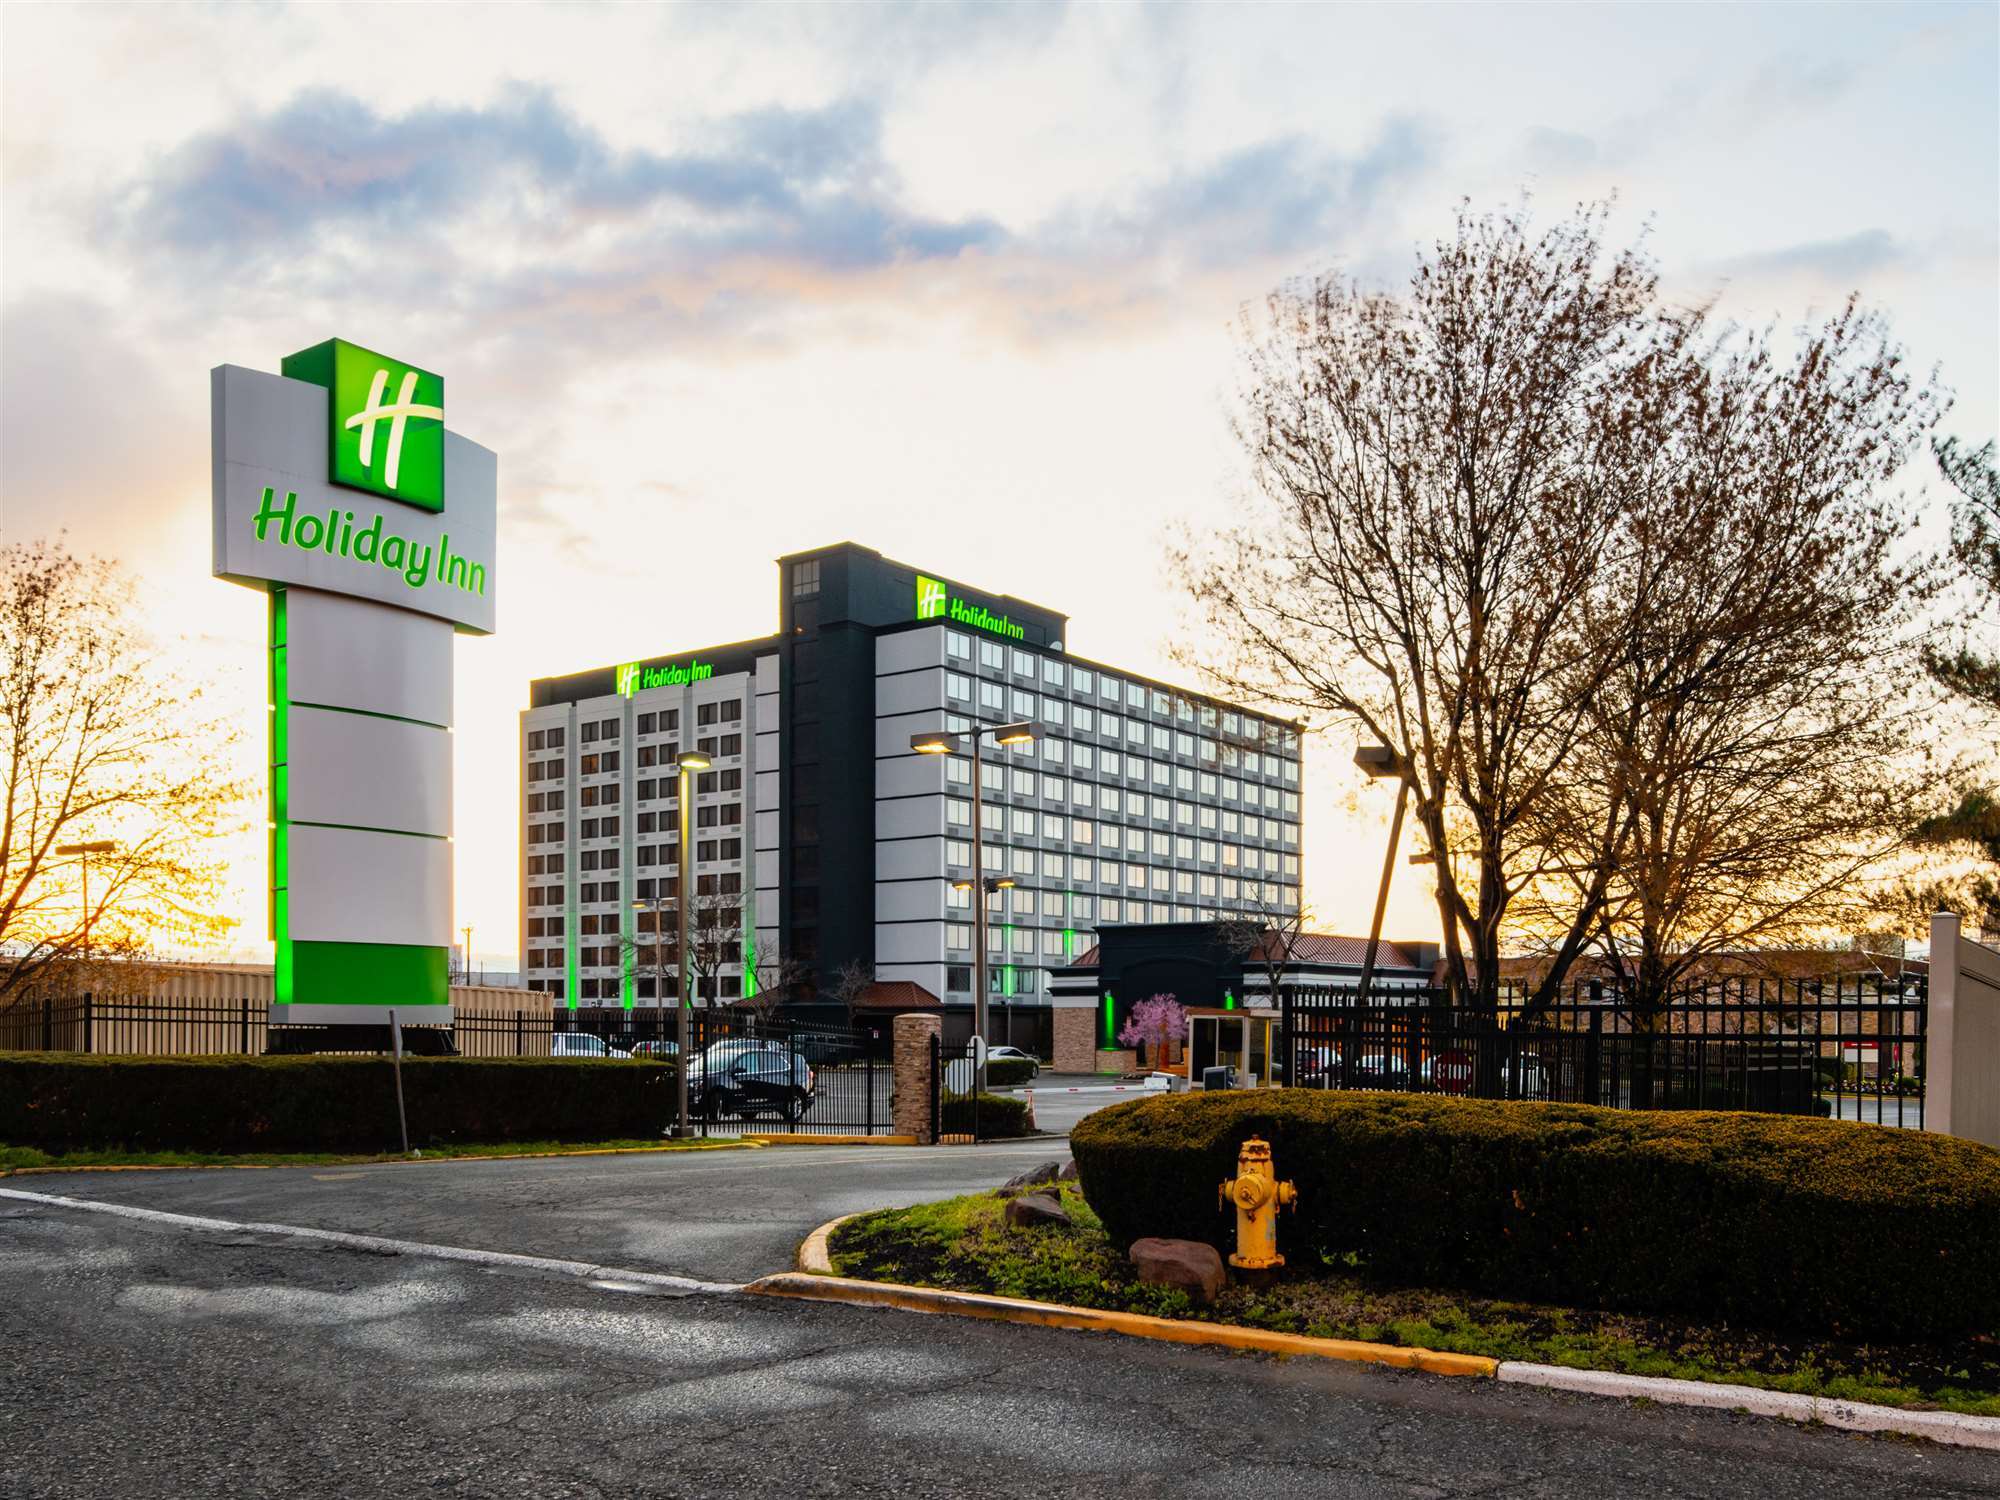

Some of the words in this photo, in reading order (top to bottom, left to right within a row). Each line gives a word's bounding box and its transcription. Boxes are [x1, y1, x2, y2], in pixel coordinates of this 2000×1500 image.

[252, 487, 431, 588] Holiday
[436, 533, 486, 597] Inn
[951, 598, 1003, 634] Holiday
[1003, 615, 1024, 640] Inn
[643, 664, 691, 688] Holiday
[691, 660, 713, 681] Inn
